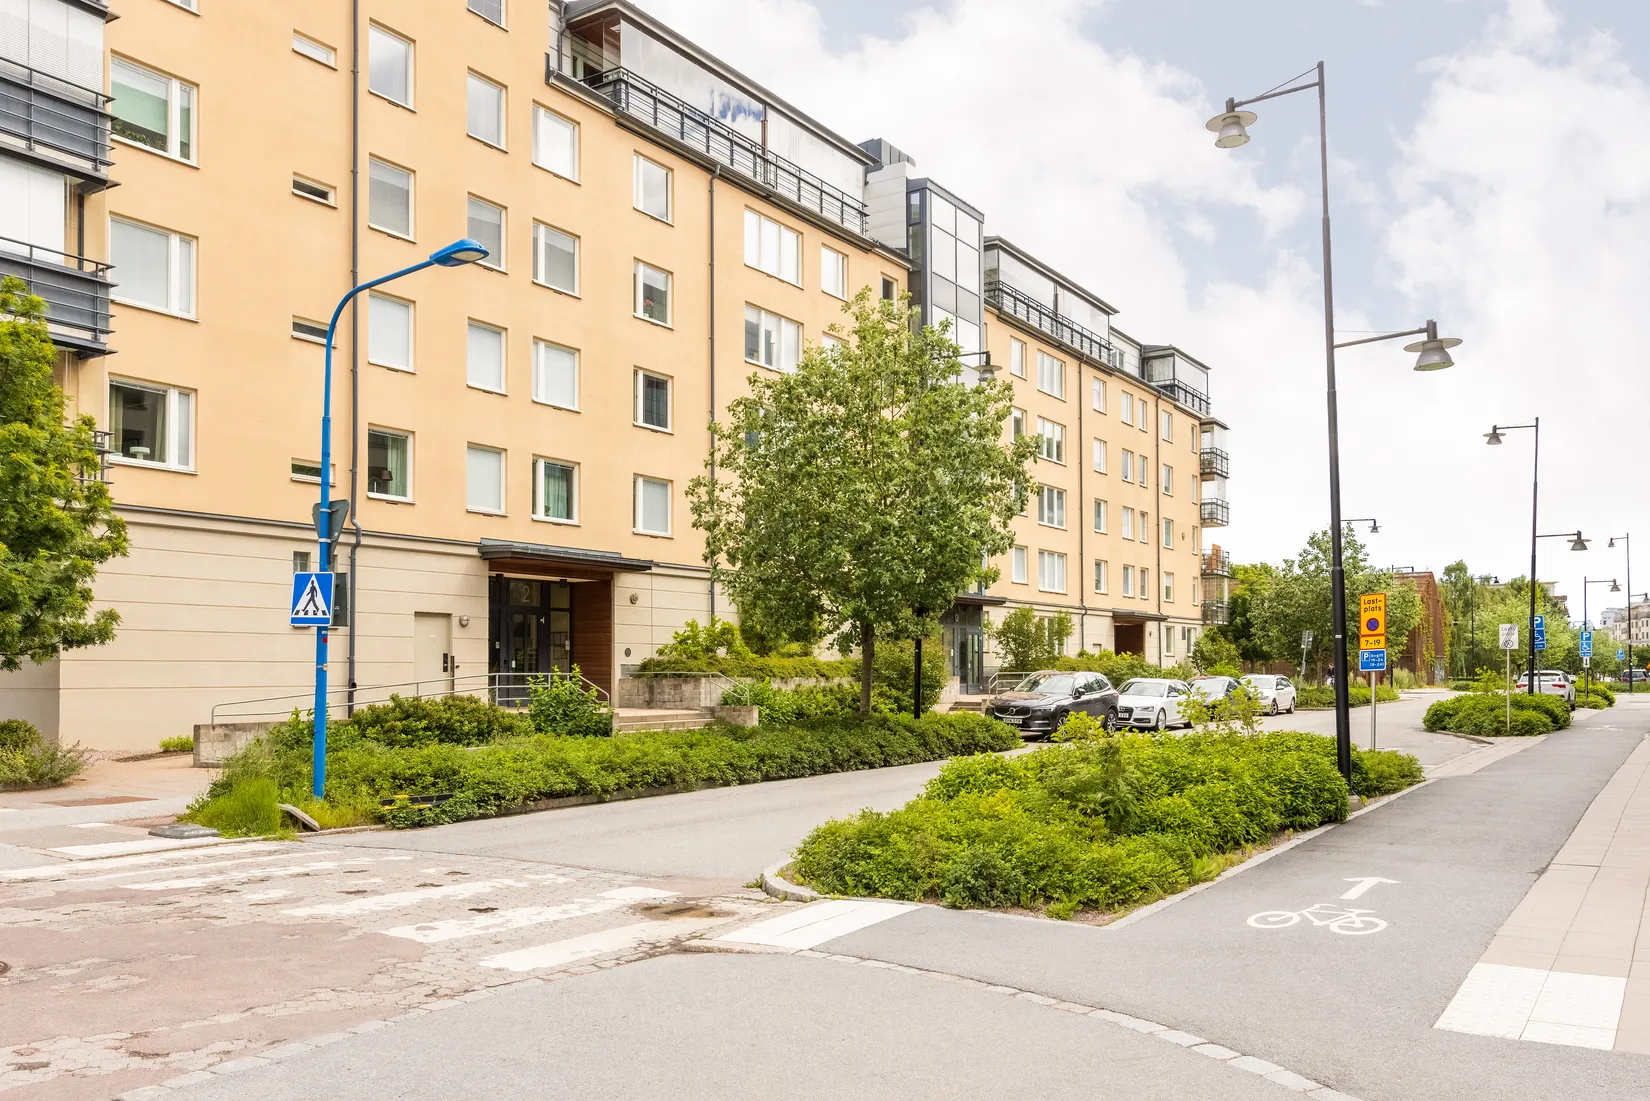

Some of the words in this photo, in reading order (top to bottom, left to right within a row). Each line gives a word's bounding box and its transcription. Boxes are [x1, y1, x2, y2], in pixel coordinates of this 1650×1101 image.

[1363, 605, 1382, 613] plats
[1534, 616, 1541, 628] P
[1583, 632, 1590, 640] P
[1364, 653, 1369, 661] P
